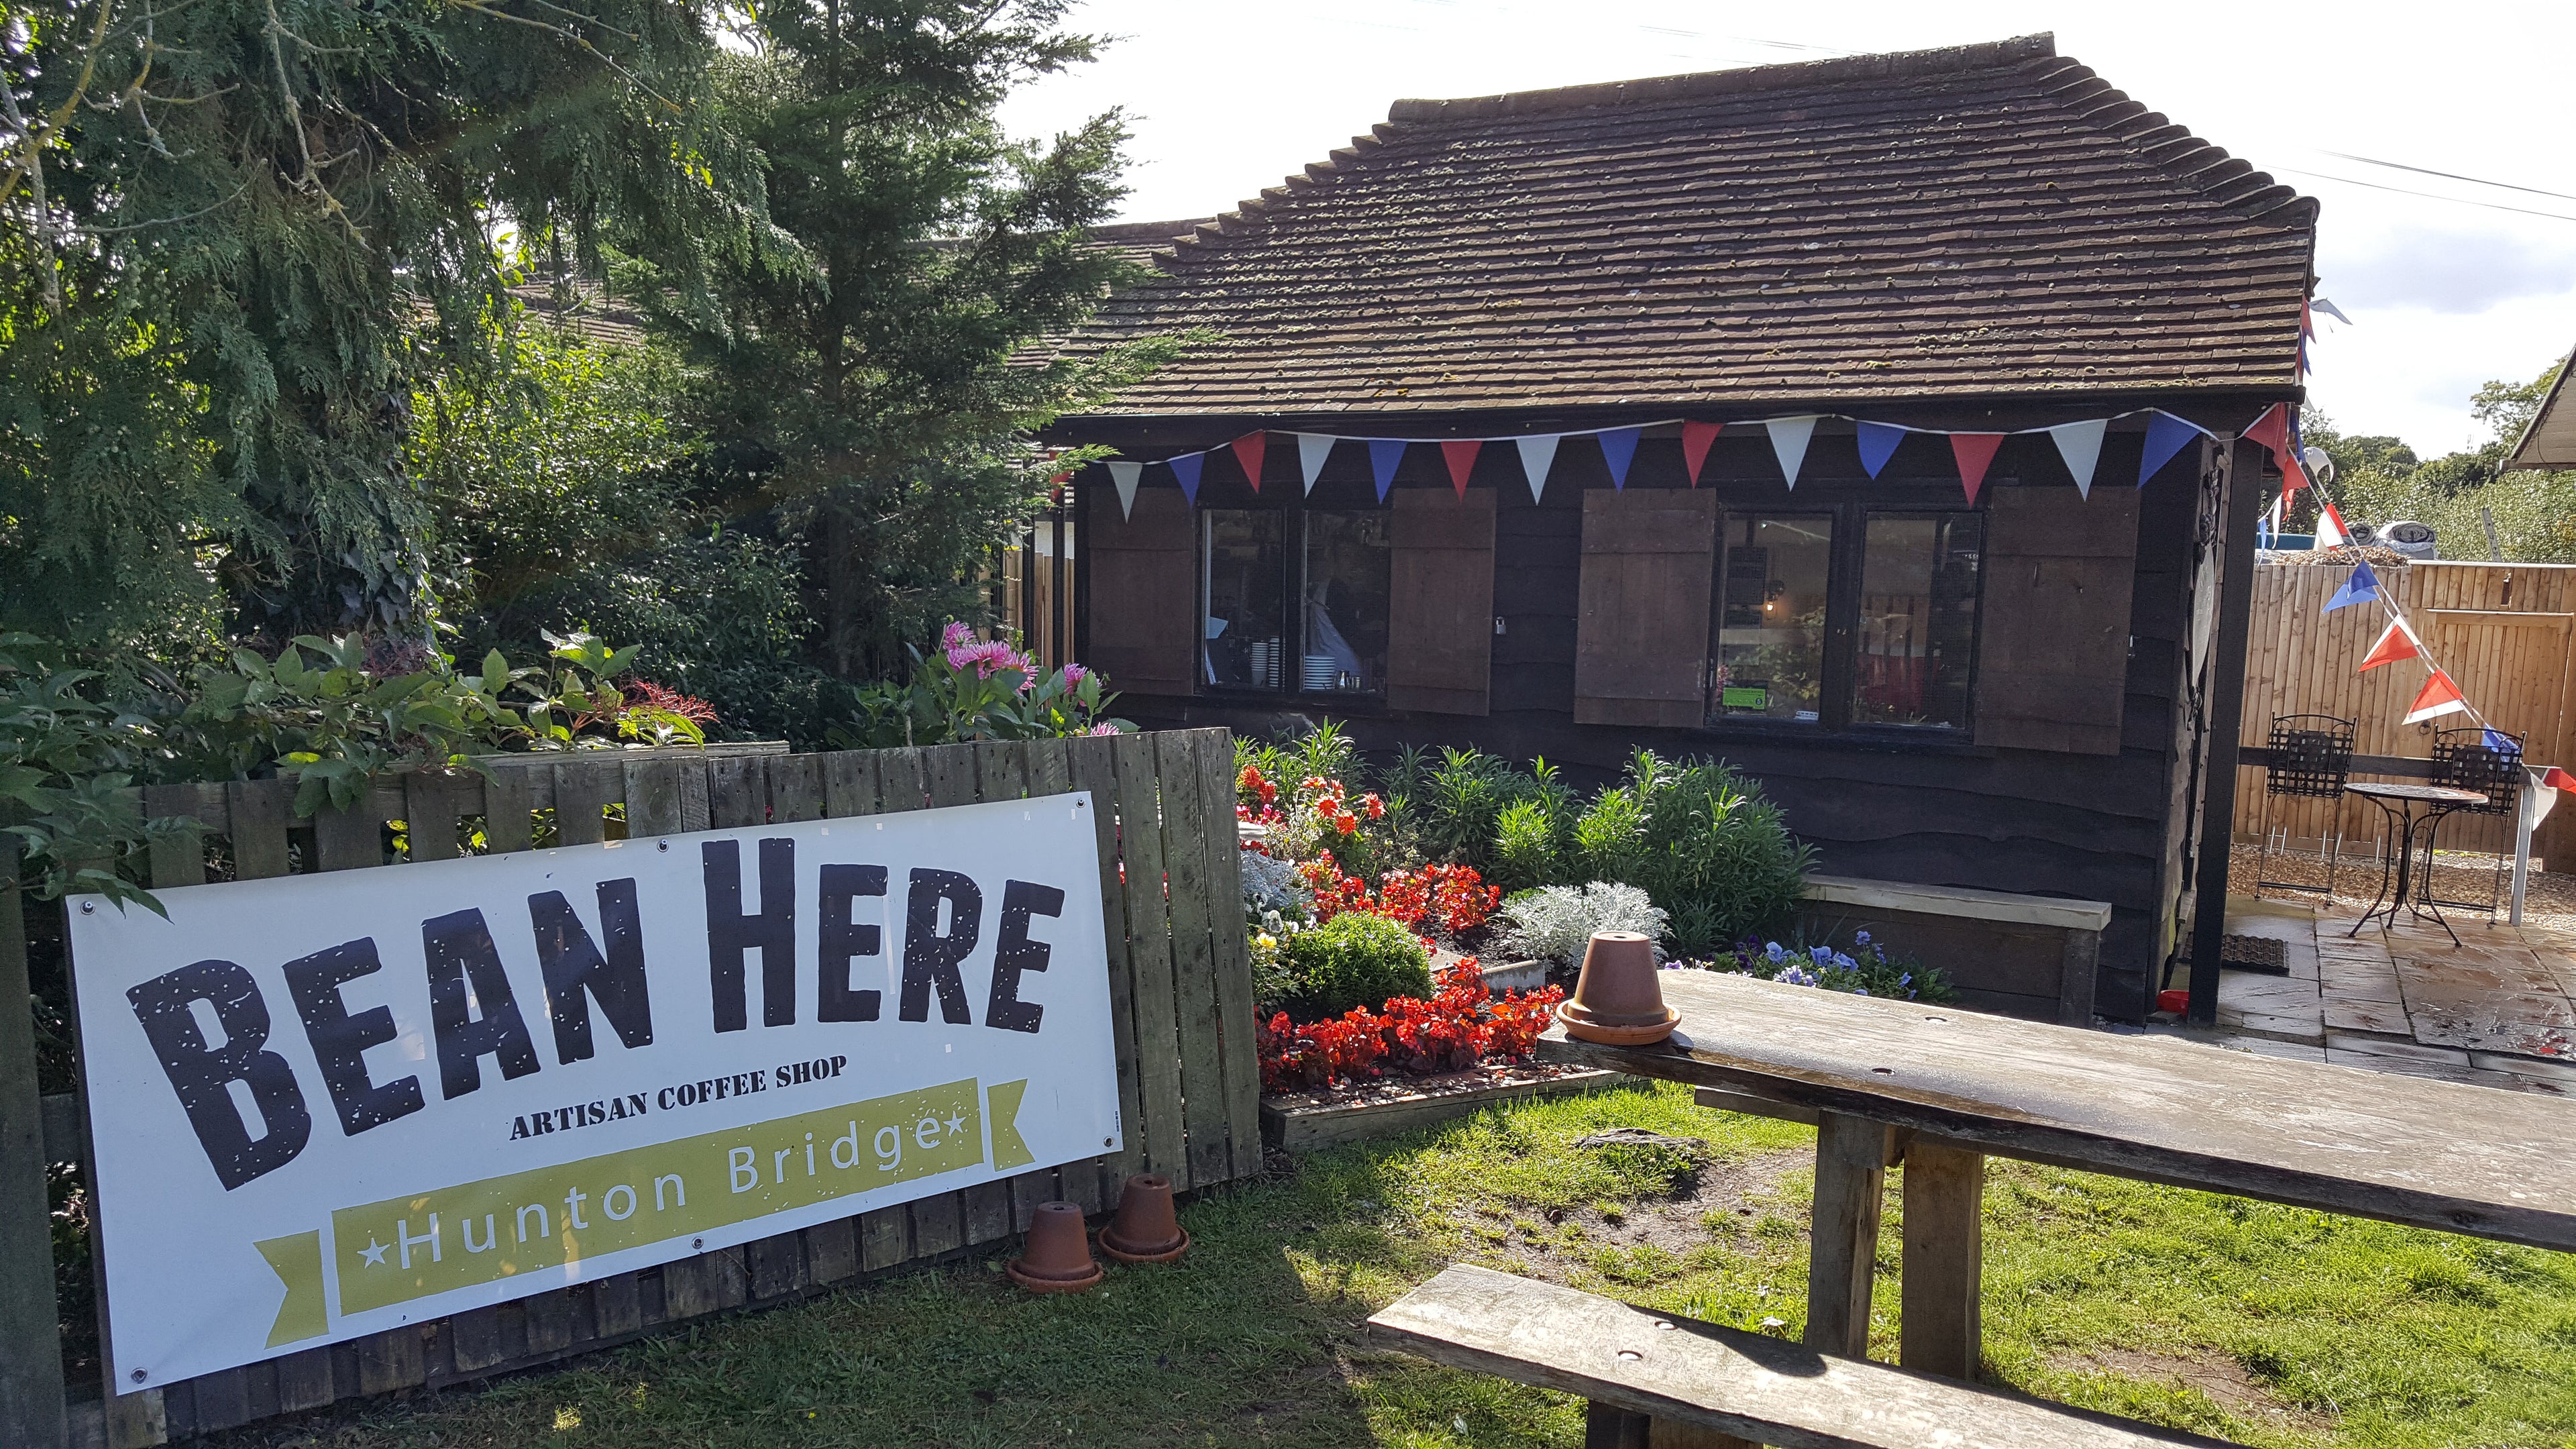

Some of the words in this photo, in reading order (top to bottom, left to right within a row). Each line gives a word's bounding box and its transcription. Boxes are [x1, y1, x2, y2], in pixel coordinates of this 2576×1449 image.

[125, 877, 654, 1192] BEAN
[701, 837, 1065, 1034] HERE
[509, 1092, 647, 1141] ARTISAN
[657, 1071, 767, 1110] COFFEE
[775, 1055, 847, 1088] SHOP
[397, 1174, 686, 1270] Hunton
[729, 1117, 941, 1193] Bridge
